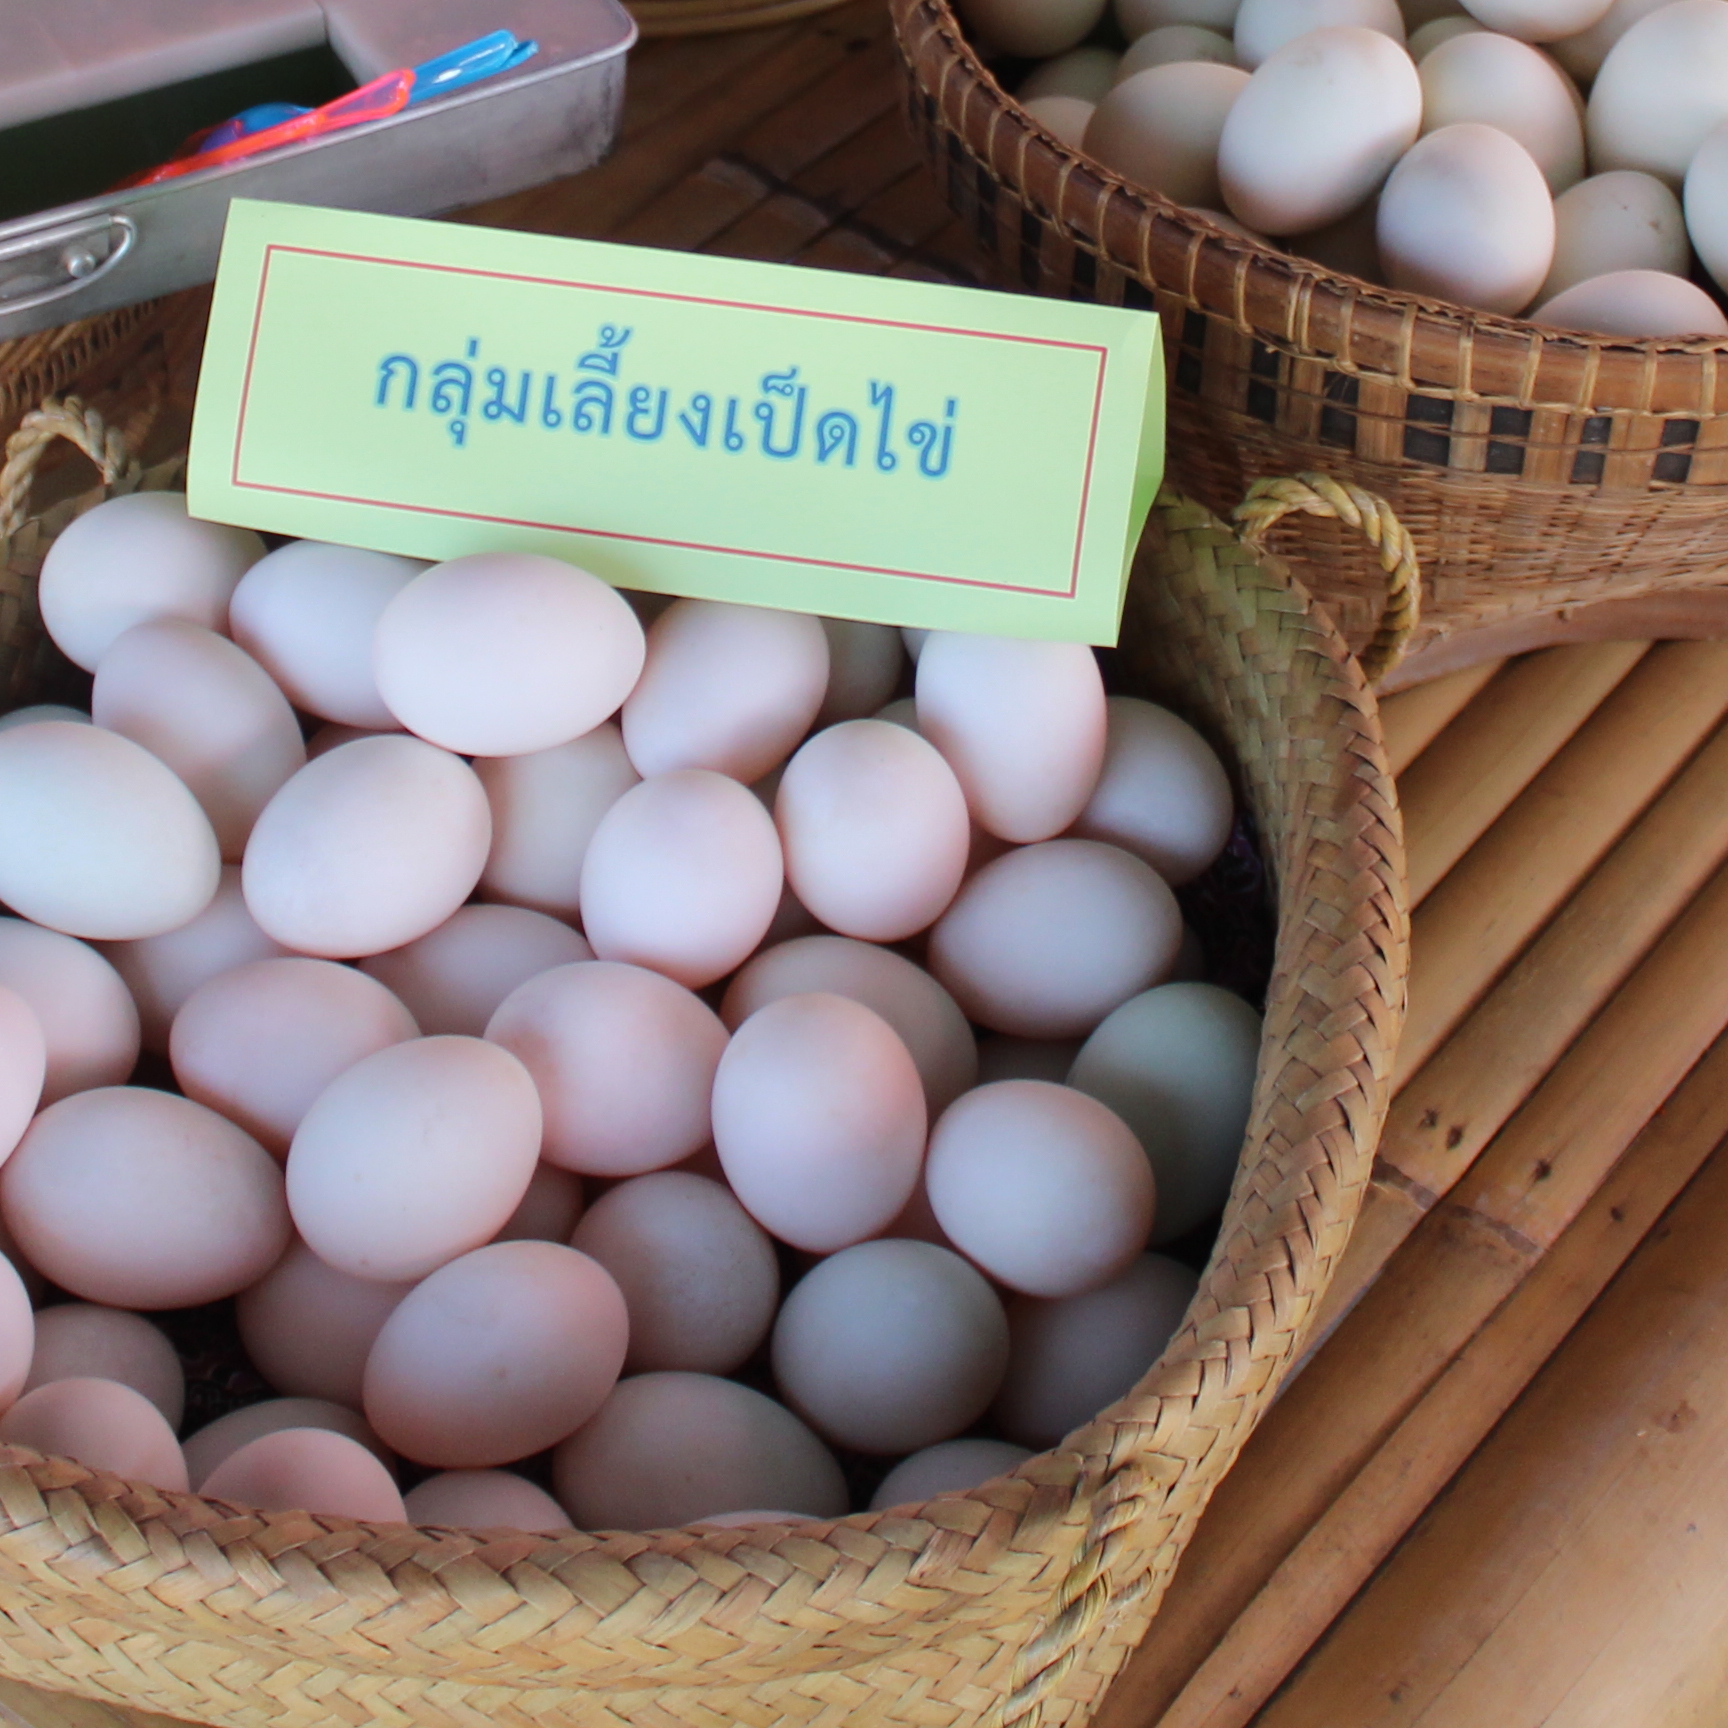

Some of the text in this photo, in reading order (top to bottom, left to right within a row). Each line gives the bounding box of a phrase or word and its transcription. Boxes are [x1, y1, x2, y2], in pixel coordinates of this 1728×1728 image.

[375, 324, 959, 480] กลุ่มเลี้ยงเป็ดไข่
